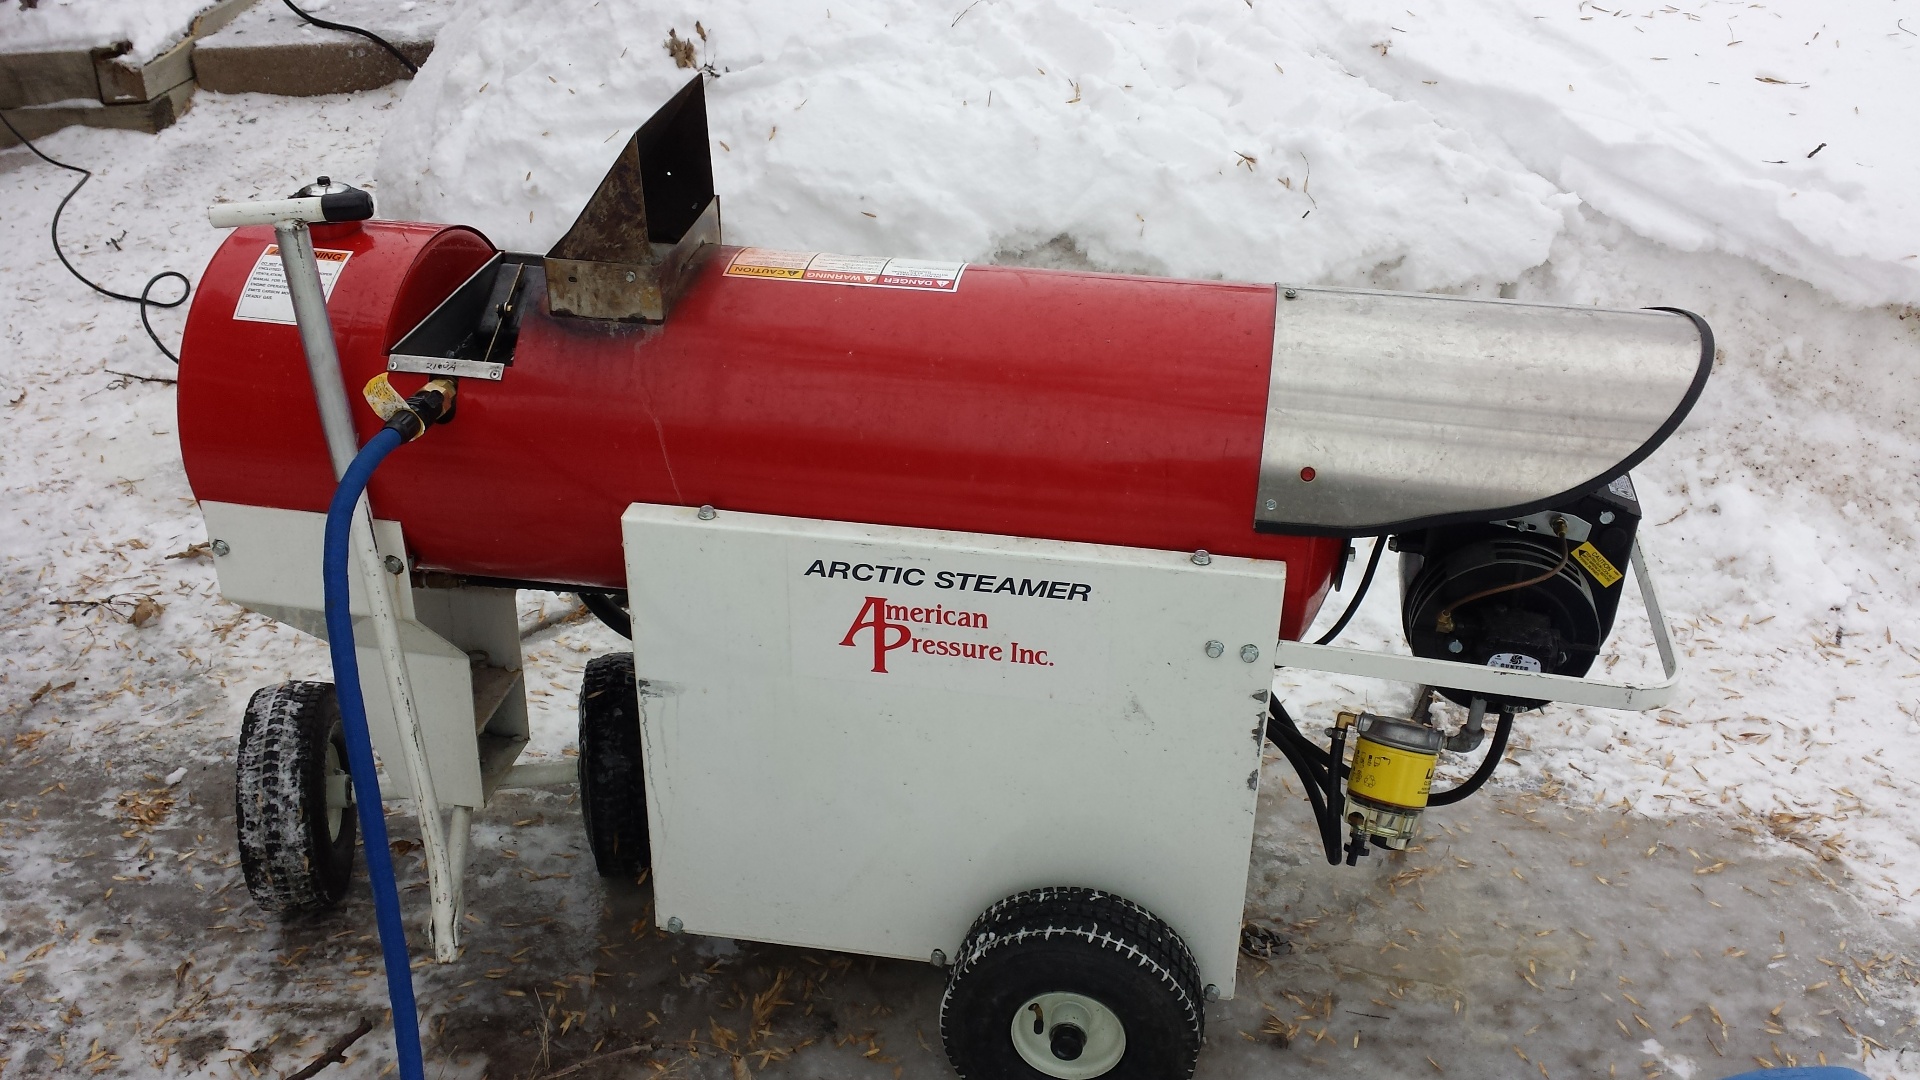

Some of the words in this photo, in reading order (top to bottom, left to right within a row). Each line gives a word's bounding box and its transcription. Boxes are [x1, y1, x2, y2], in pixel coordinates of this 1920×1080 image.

[314, 251, 343, 261] NING
[735, 266, 785, 276] CAUTION
[807, 272, 860, 281] WARNING
[884, 277, 932, 286] DANGER
[1591, 551, 1613, 572] CAUTION
[804, 559, 925, 586] ARCTIC
[934, 571, 1092, 601] STEAMER
[838, 596, 989, 647] American
[870, 622, 1003, 673] Pressure
[1010, 642, 1054, 667] Inc.
